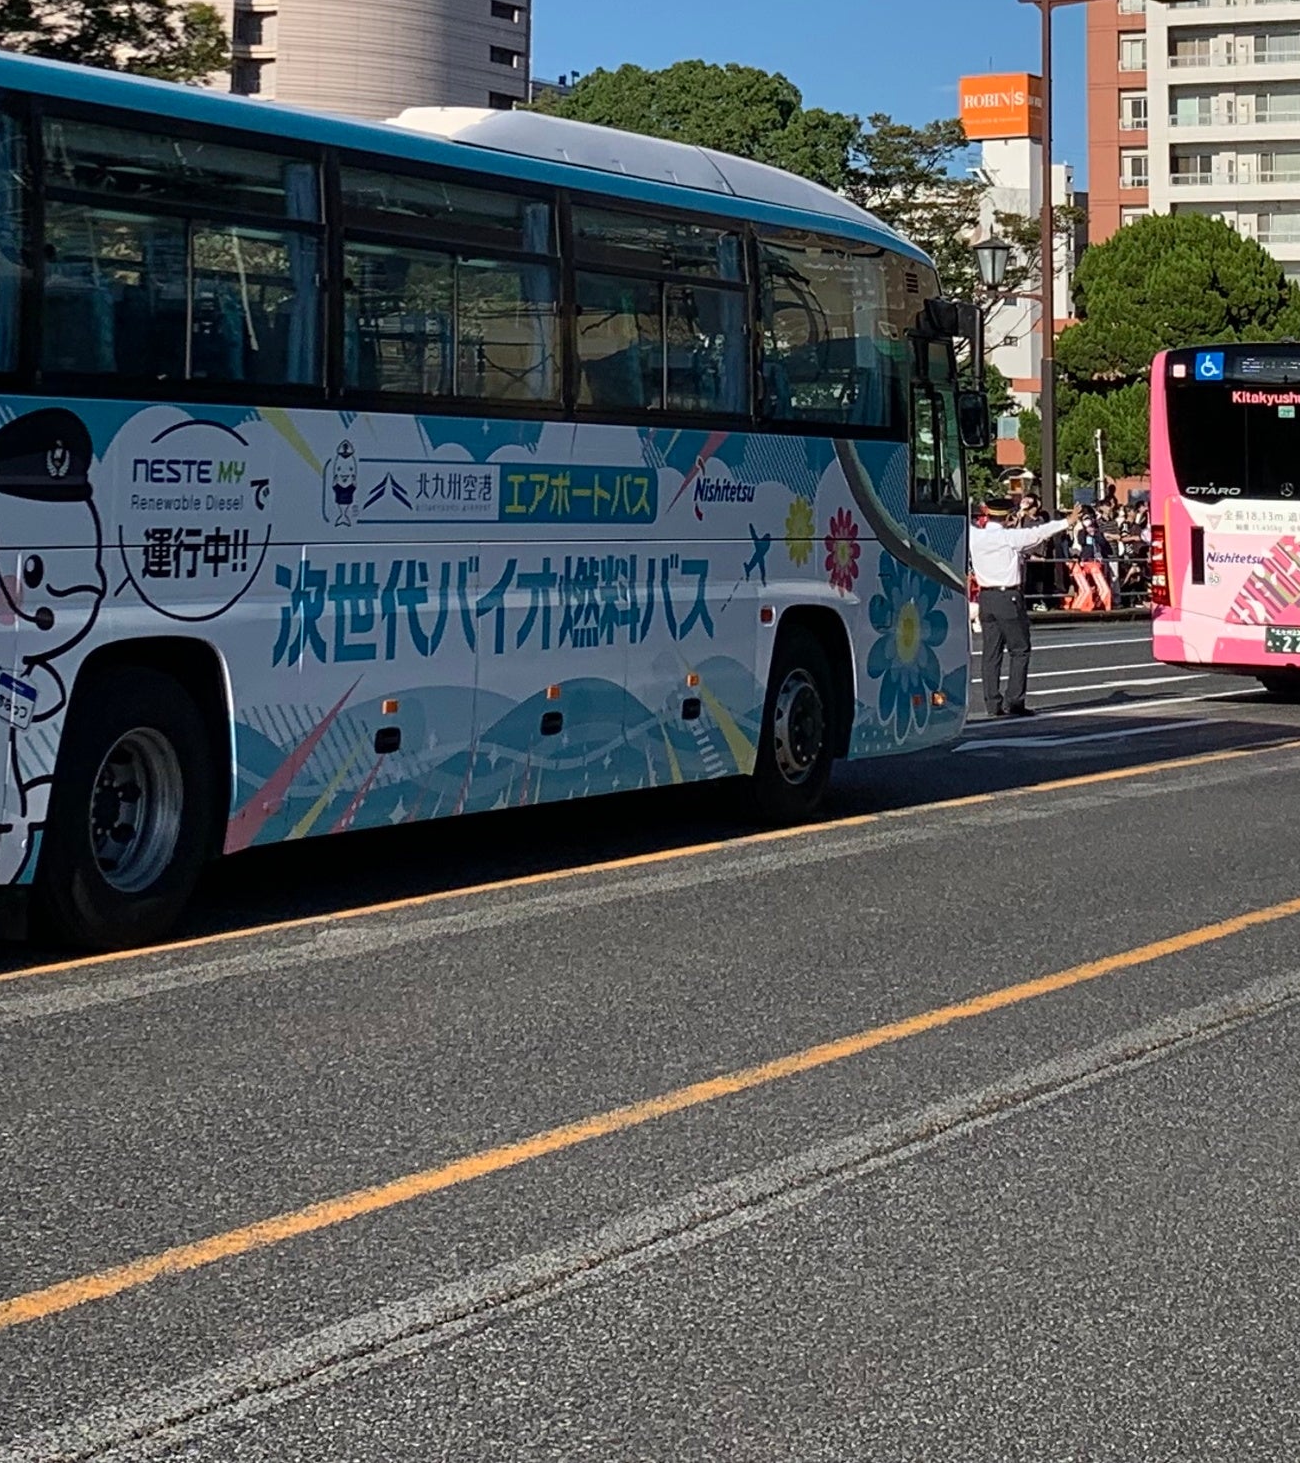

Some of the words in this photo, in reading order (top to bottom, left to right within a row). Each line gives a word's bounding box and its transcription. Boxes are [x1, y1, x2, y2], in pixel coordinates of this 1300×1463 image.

[133, 459, 212, 483] NESTE
[217, 461, 246, 483] MY
[250, 478, 270, 511] で
[415, 472, 492, 501] 北九州空港
[505, 470, 650, 516] エアポートバス
[693, 477, 755, 503] Nishitetsu
[1186, 485, 1241, 495] CITARO
[131, 494, 201, 511] Renewable
[206, 495, 244, 511] Diesel
[1207, 552, 1264, 564] Nishitetsu
[272, 554, 715, 668] 次世代バイオ燃料バス
